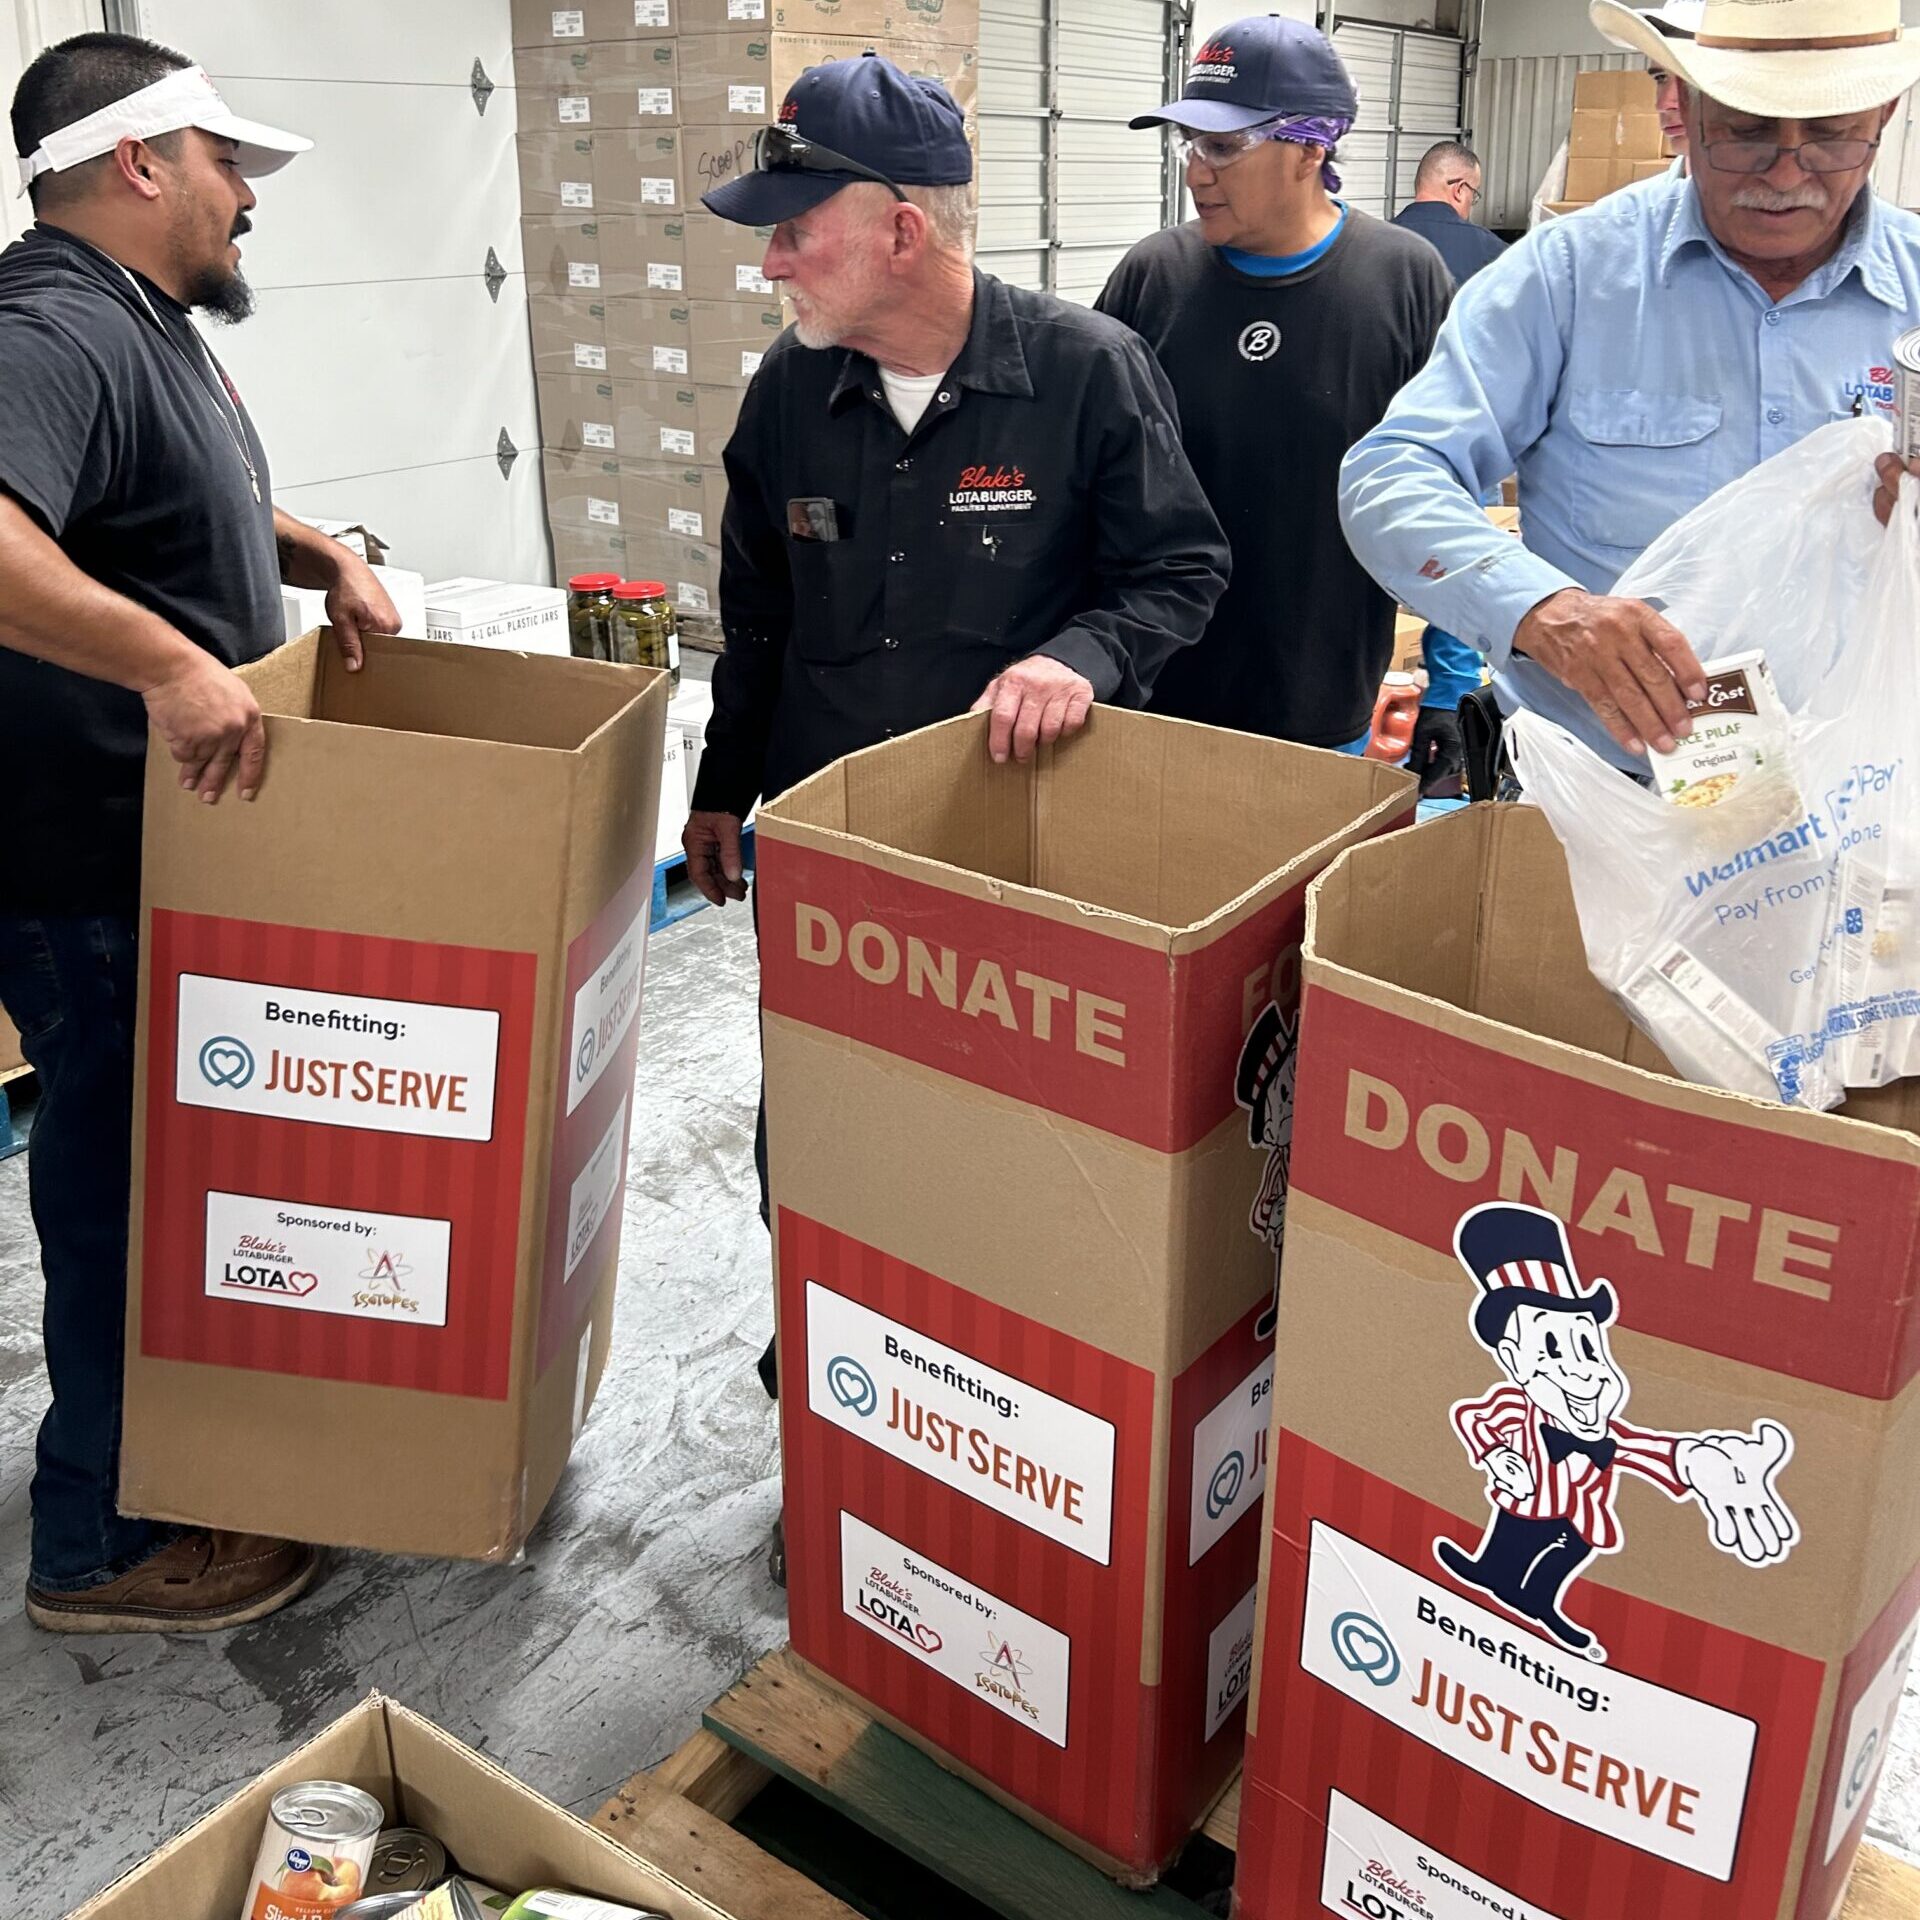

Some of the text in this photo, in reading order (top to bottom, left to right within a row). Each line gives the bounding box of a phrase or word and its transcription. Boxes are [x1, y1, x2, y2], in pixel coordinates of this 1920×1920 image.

[1845, 382, 1893, 402] LOTAB
[949, 489, 1033, 504] LOTABURGER
[959, 465, 1026, 489] Blake's
[434, 630, 453, 642] JARS
[486, 624, 505, 638] GAL.
[507, 615, 539, 632] PLASTIC
[541, 610, 559, 628] JARS
[1708, 684, 1746, 707] East
[1705, 722, 1742, 740] PILAF
[1692, 750, 1738, 769] Original
[1684, 813, 1827, 898] Walmart
[1714, 899, 1759, 926] Pay
[1764, 875, 1825, 907] from
[795, 901, 1127, 1068] DONATE
[1242, 942, 1300, 1038] FO
[265, 1001, 406, 1041] Benefitting:
[1344, 1068, 1840, 1301] DONATE
[238, 1235, 288, 1254] Blake's
[276, 1212, 377, 1238] Sponsored by:
[233, 1248, 294, 1264] LOTABURGER
[225, 1263, 288, 1290] LOTA
[885, 1334, 1019, 1418] Benefitting:
[865, 1577, 920, 1615] LOTABURGER
[870, 1566, 913, 1601] Blake's
[903, 1557, 998, 1620] Sponsored by:
[859, 1588, 916, 1640] LOTA
[1416, 1595, 1610, 1712] Benefitting:
[1346, 1880, 1412, 1920] LOT
[1358, 1869, 1434, 1920] LOTABURGER
[1366, 1859, 1427, 1905] Blake's
[1416, 1855, 1515, 1919] Sponsored
